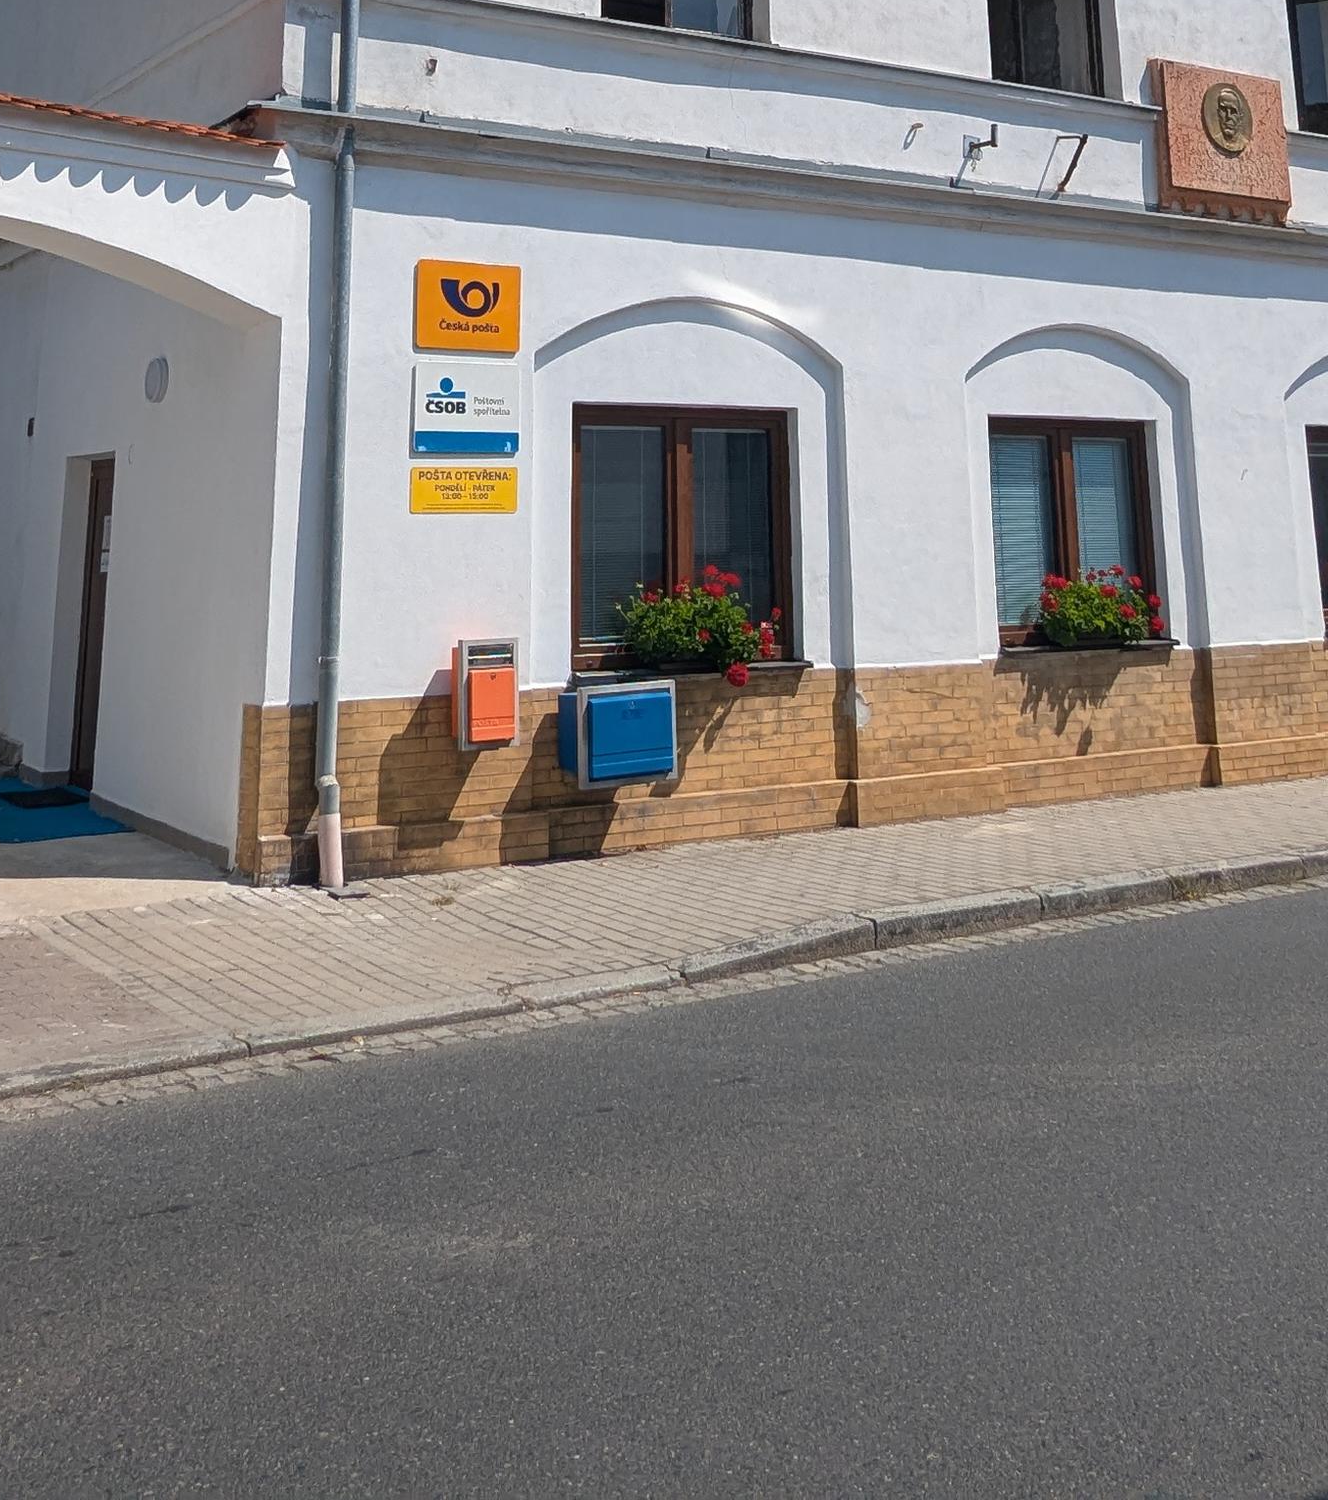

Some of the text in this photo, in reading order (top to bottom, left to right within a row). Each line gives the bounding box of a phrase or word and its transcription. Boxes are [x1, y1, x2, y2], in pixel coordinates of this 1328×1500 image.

[439, 318, 500, 333] Česká pošta
[473, 397, 505, 405] Poštovní
[425, 399, 466, 414] ČSOB
[473, 407, 511, 416] spořitelna
[418, 469, 512, 481] POŠTA OTEVŘENA:
[434, 483, 467, 492] PONDĚLÍ
[472, 483, 495, 492] PÁTEK
